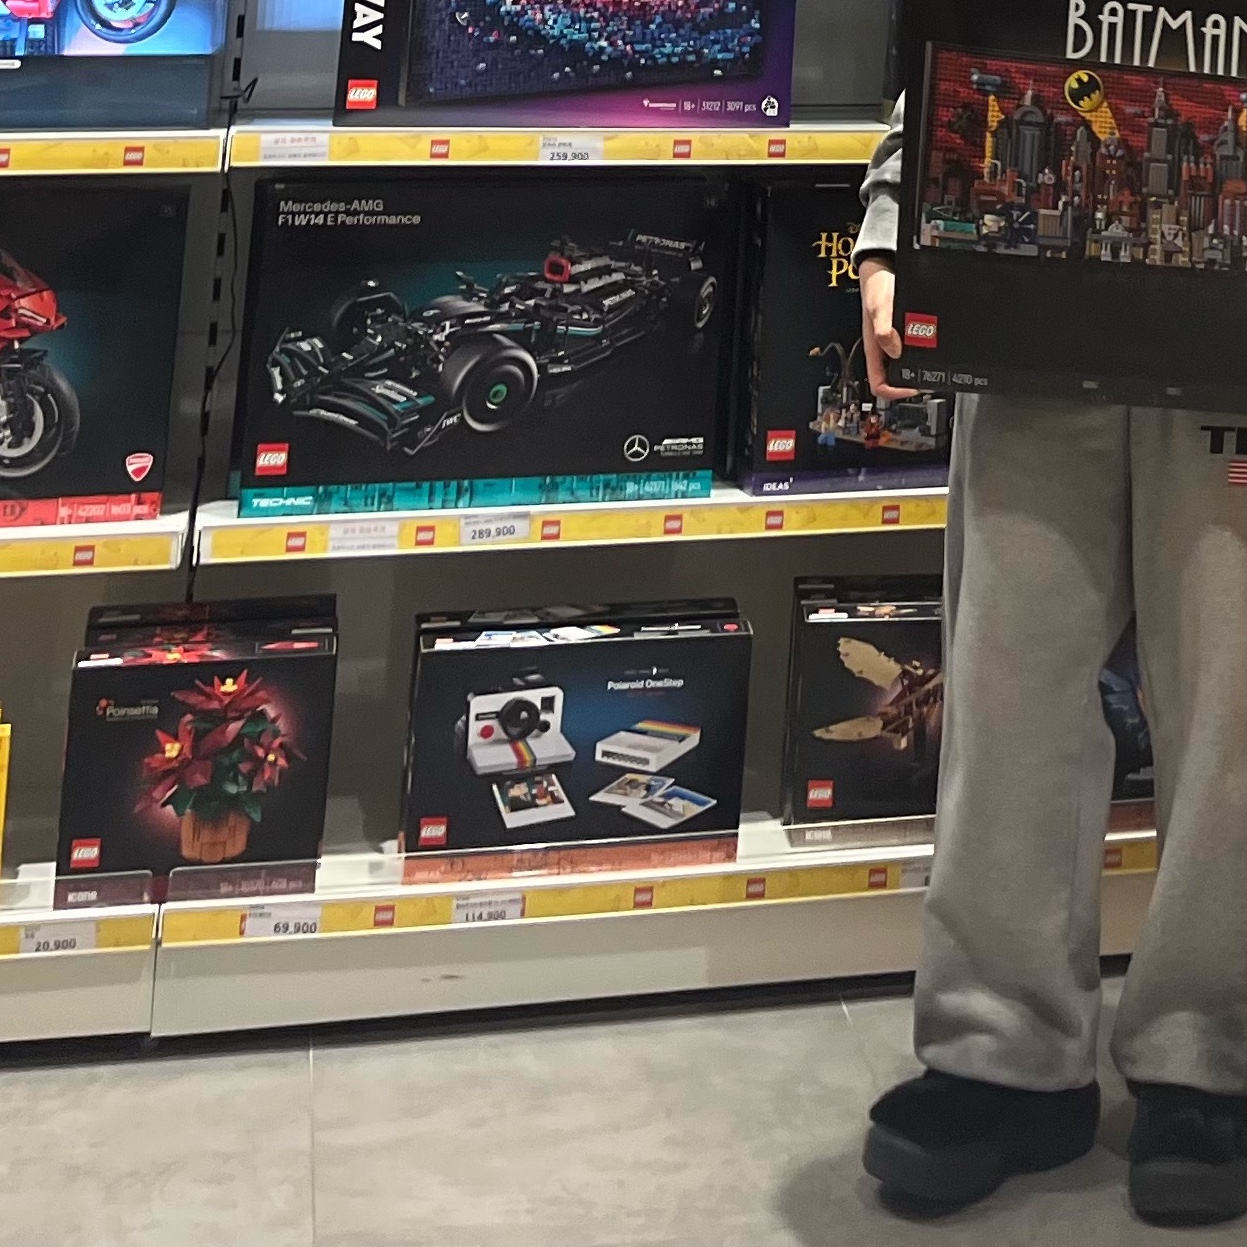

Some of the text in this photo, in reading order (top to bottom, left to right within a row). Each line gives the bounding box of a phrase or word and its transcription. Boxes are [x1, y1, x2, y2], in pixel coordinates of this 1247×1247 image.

[347, 87, 378, 100] LEGO
[745, 104, 758, 115] pcs
[279, 200, 385, 213] Mercedes-AMG
[278, 215, 422, 228] F1 W14 E Performance
[907, 323, 937, 338] LEGO
[974, 377, 989, 387] pcs
[768, 438, 796, 452] LEGO
[257, 451, 287, 467] LEGO
[763, 481, 790, 493] IDEAS
[250, 496, 313, 509] TECHNIC
[607, 678, 685, 691] Polaroid OneStep
[107, 705, 160, 718] Poinsettia
[809, 788, 832, 800] LEGO
[423, 825, 447, 838] LEGO
